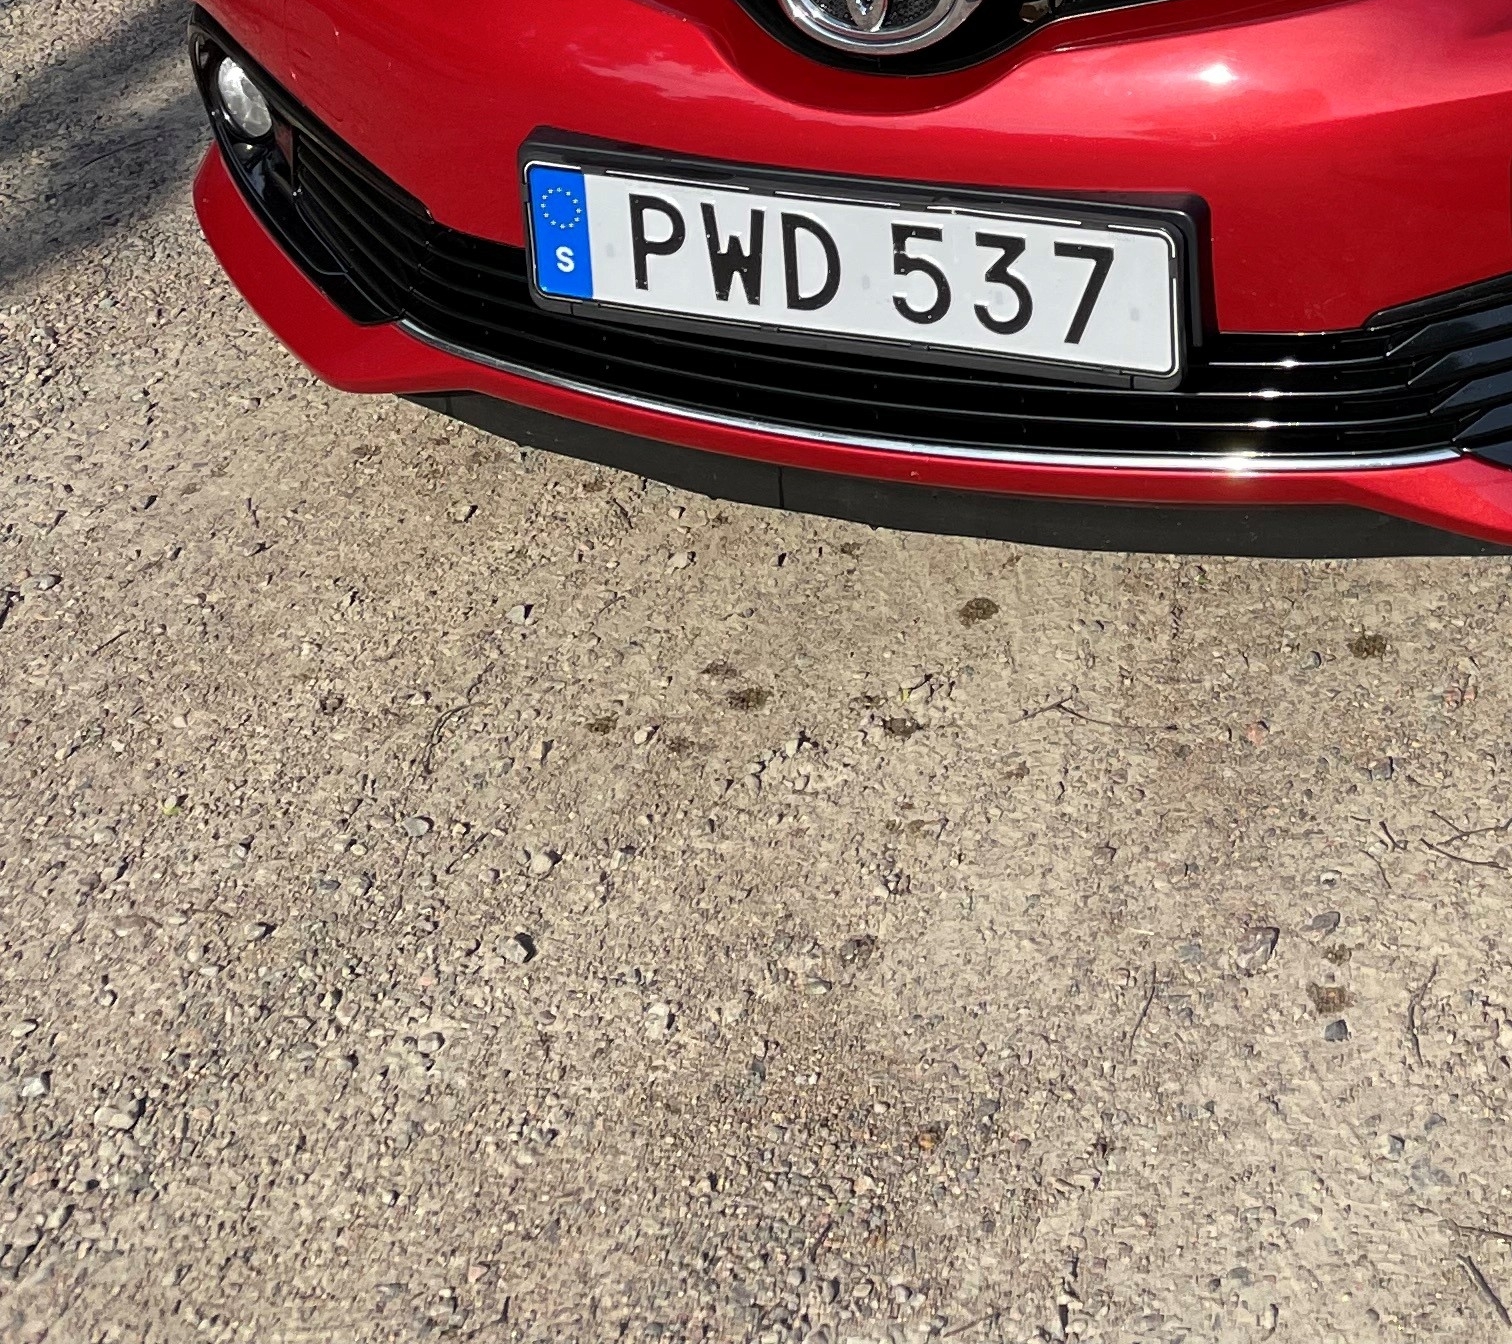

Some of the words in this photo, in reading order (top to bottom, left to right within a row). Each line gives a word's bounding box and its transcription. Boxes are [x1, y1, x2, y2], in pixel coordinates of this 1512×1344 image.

[555, 246, 575, 274] S
[627, 193, 842, 311] PWD
[890, 222, 1115, 345] 537
